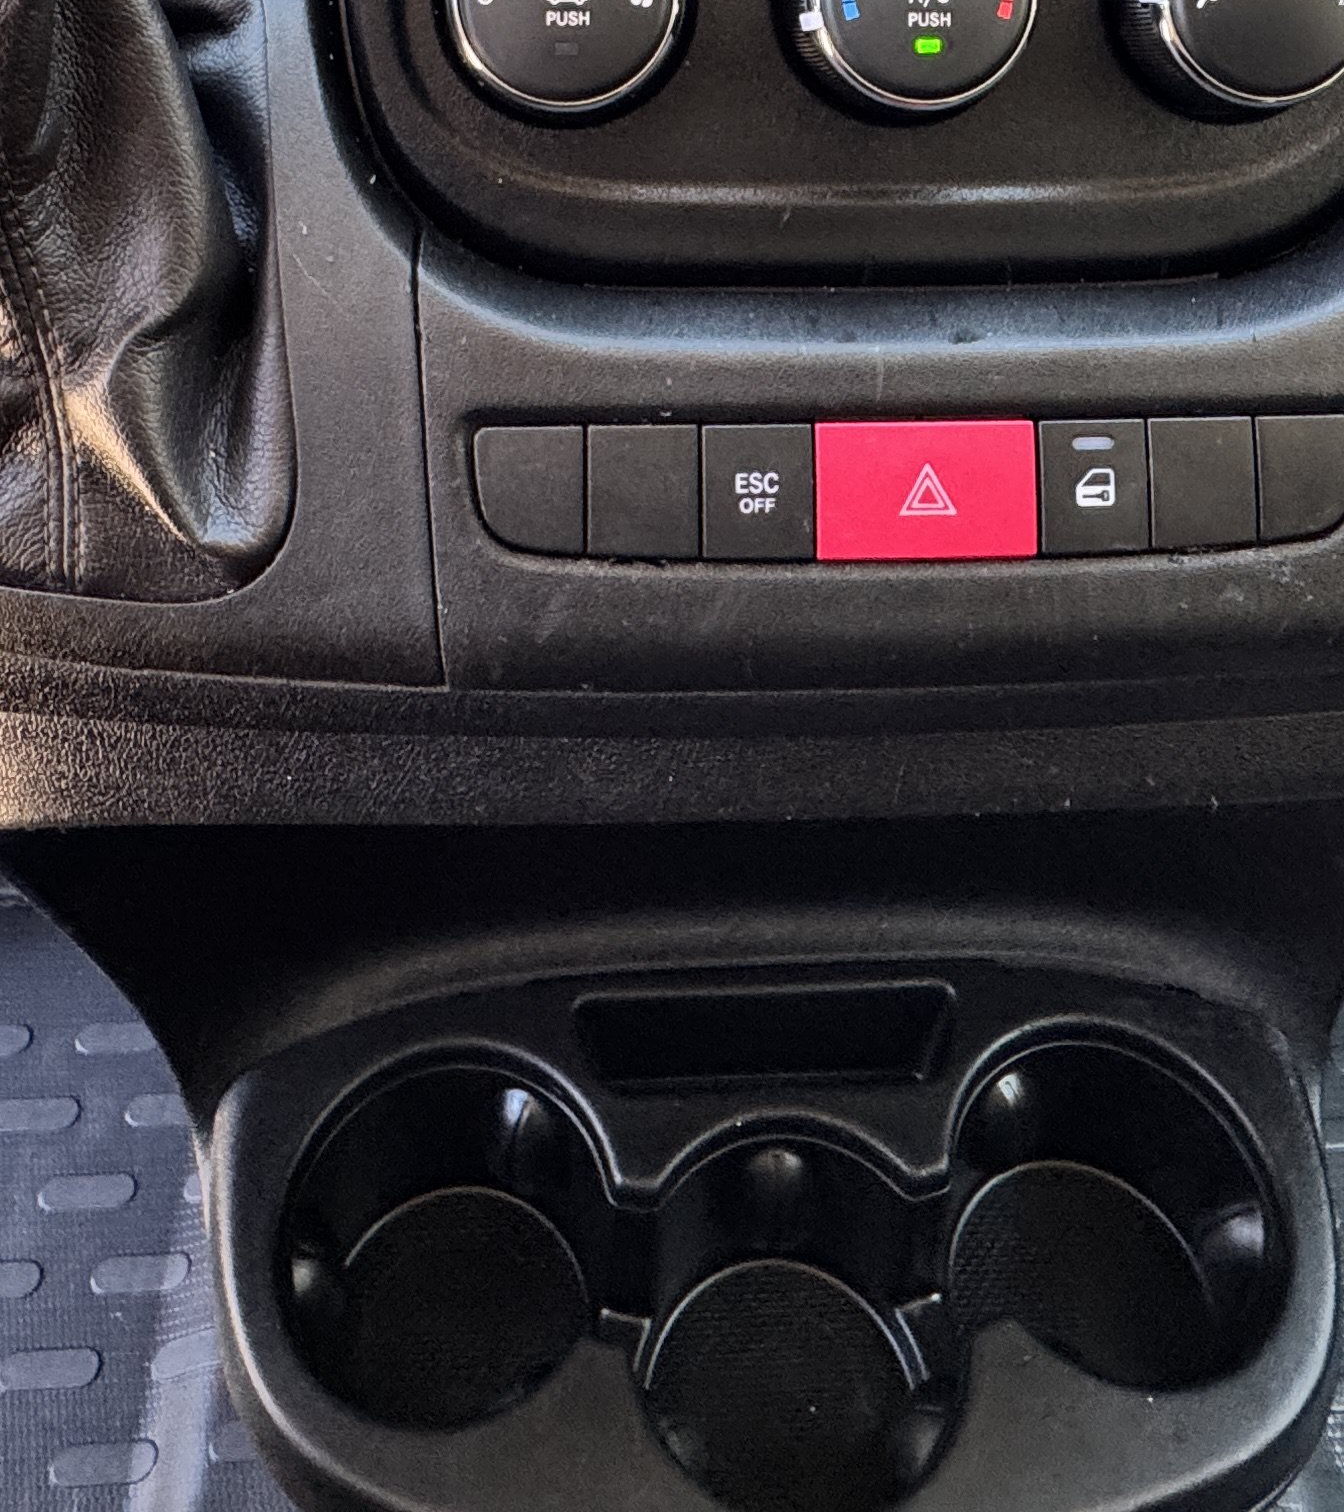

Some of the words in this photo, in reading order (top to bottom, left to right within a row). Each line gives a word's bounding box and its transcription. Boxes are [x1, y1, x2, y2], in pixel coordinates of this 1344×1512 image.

[545, 10, 591, 27] PUSH
[908, 12, 952, 28] PUSH
[734, 471, 780, 495] ESC
[739, 497, 776, 514] OFF
